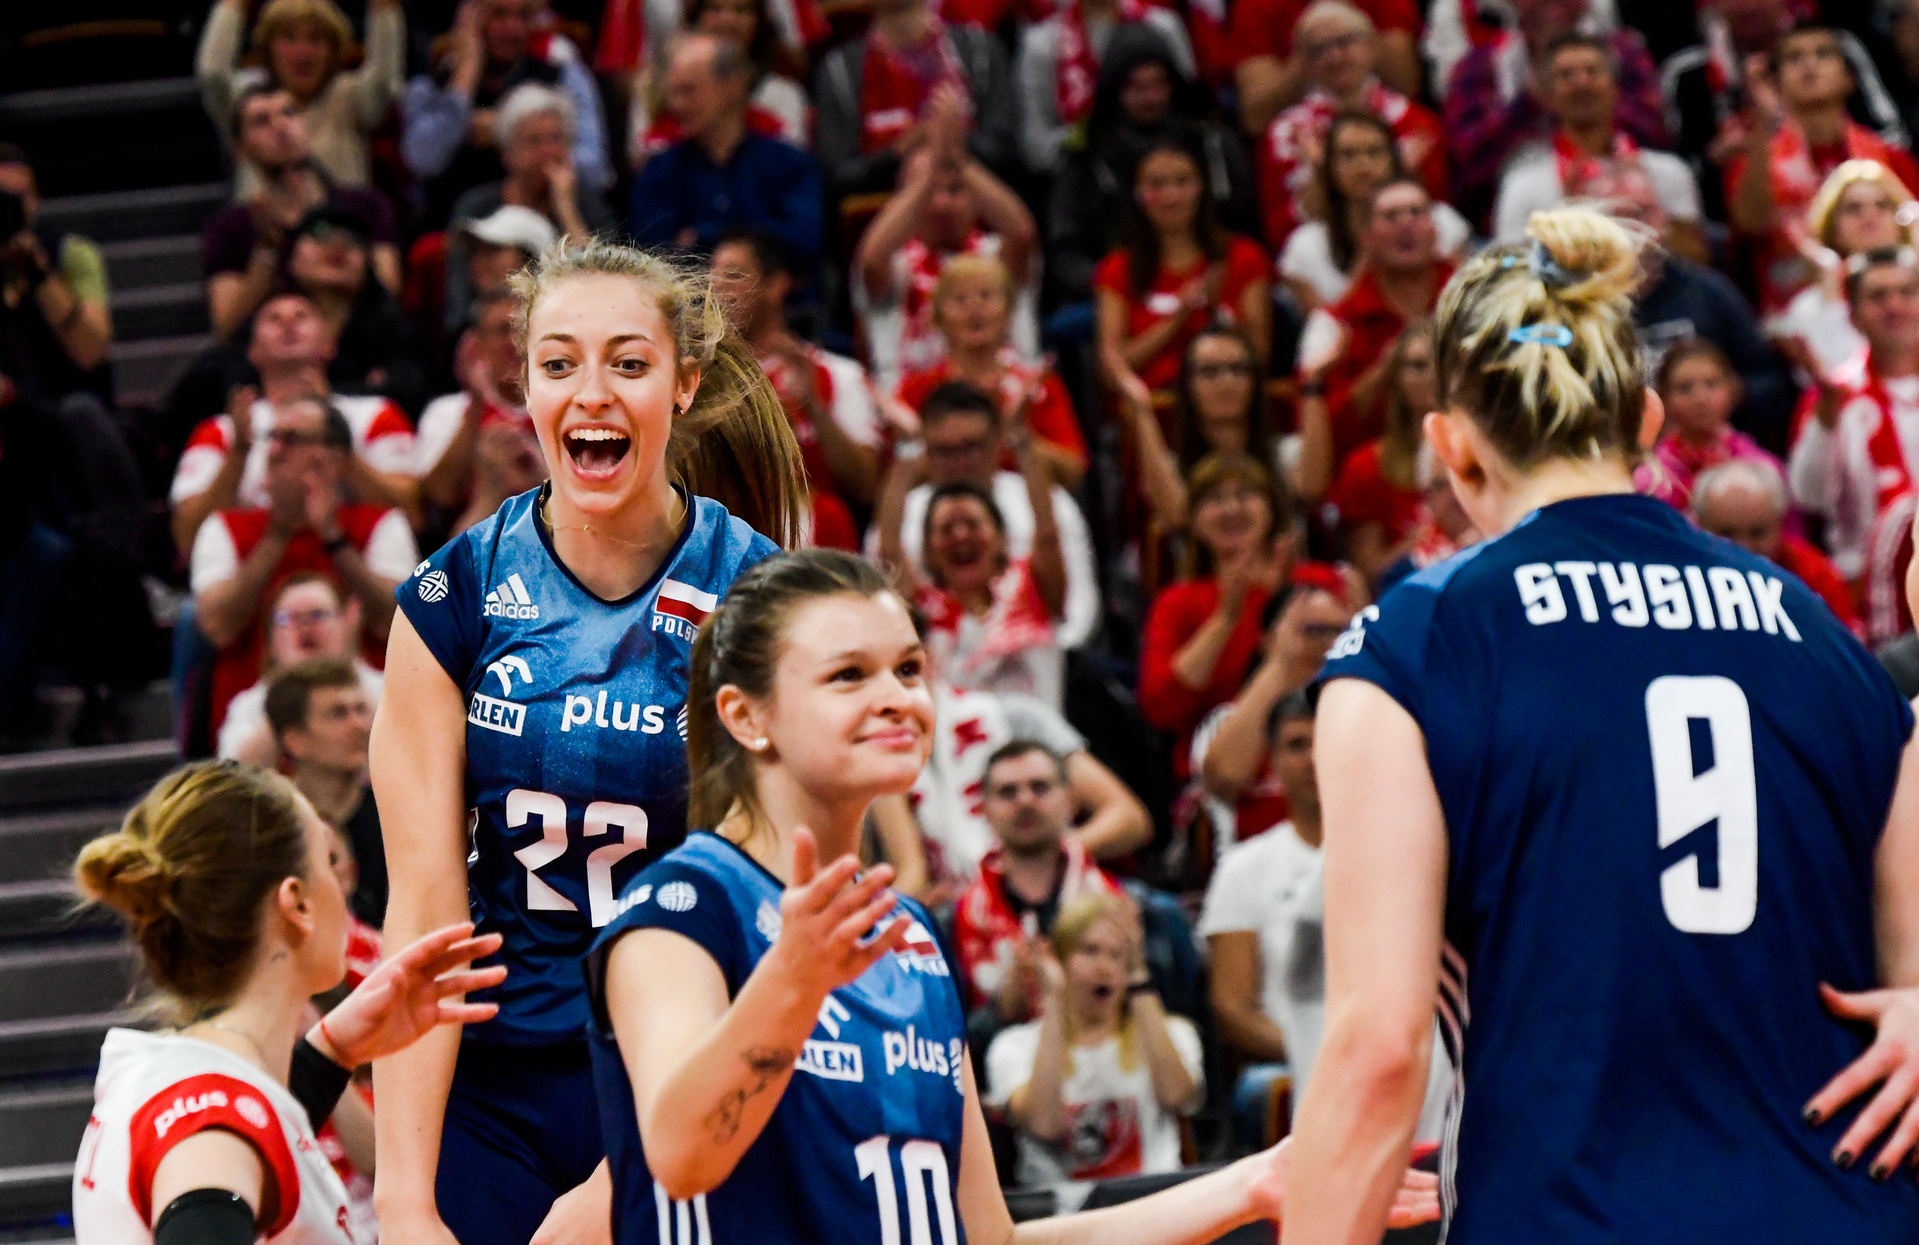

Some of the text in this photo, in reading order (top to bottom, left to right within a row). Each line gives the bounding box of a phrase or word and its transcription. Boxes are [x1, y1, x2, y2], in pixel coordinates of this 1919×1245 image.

[1513, 560, 1803, 643] STYSIAK
[560, 690, 665, 734] plus
[1645, 675, 1758, 935] 9
[506, 788, 649, 928] 22
[882, 1024, 949, 1077] plus
[153, 1090, 229, 1139] plus
[853, 1133, 958, 1245] 10
